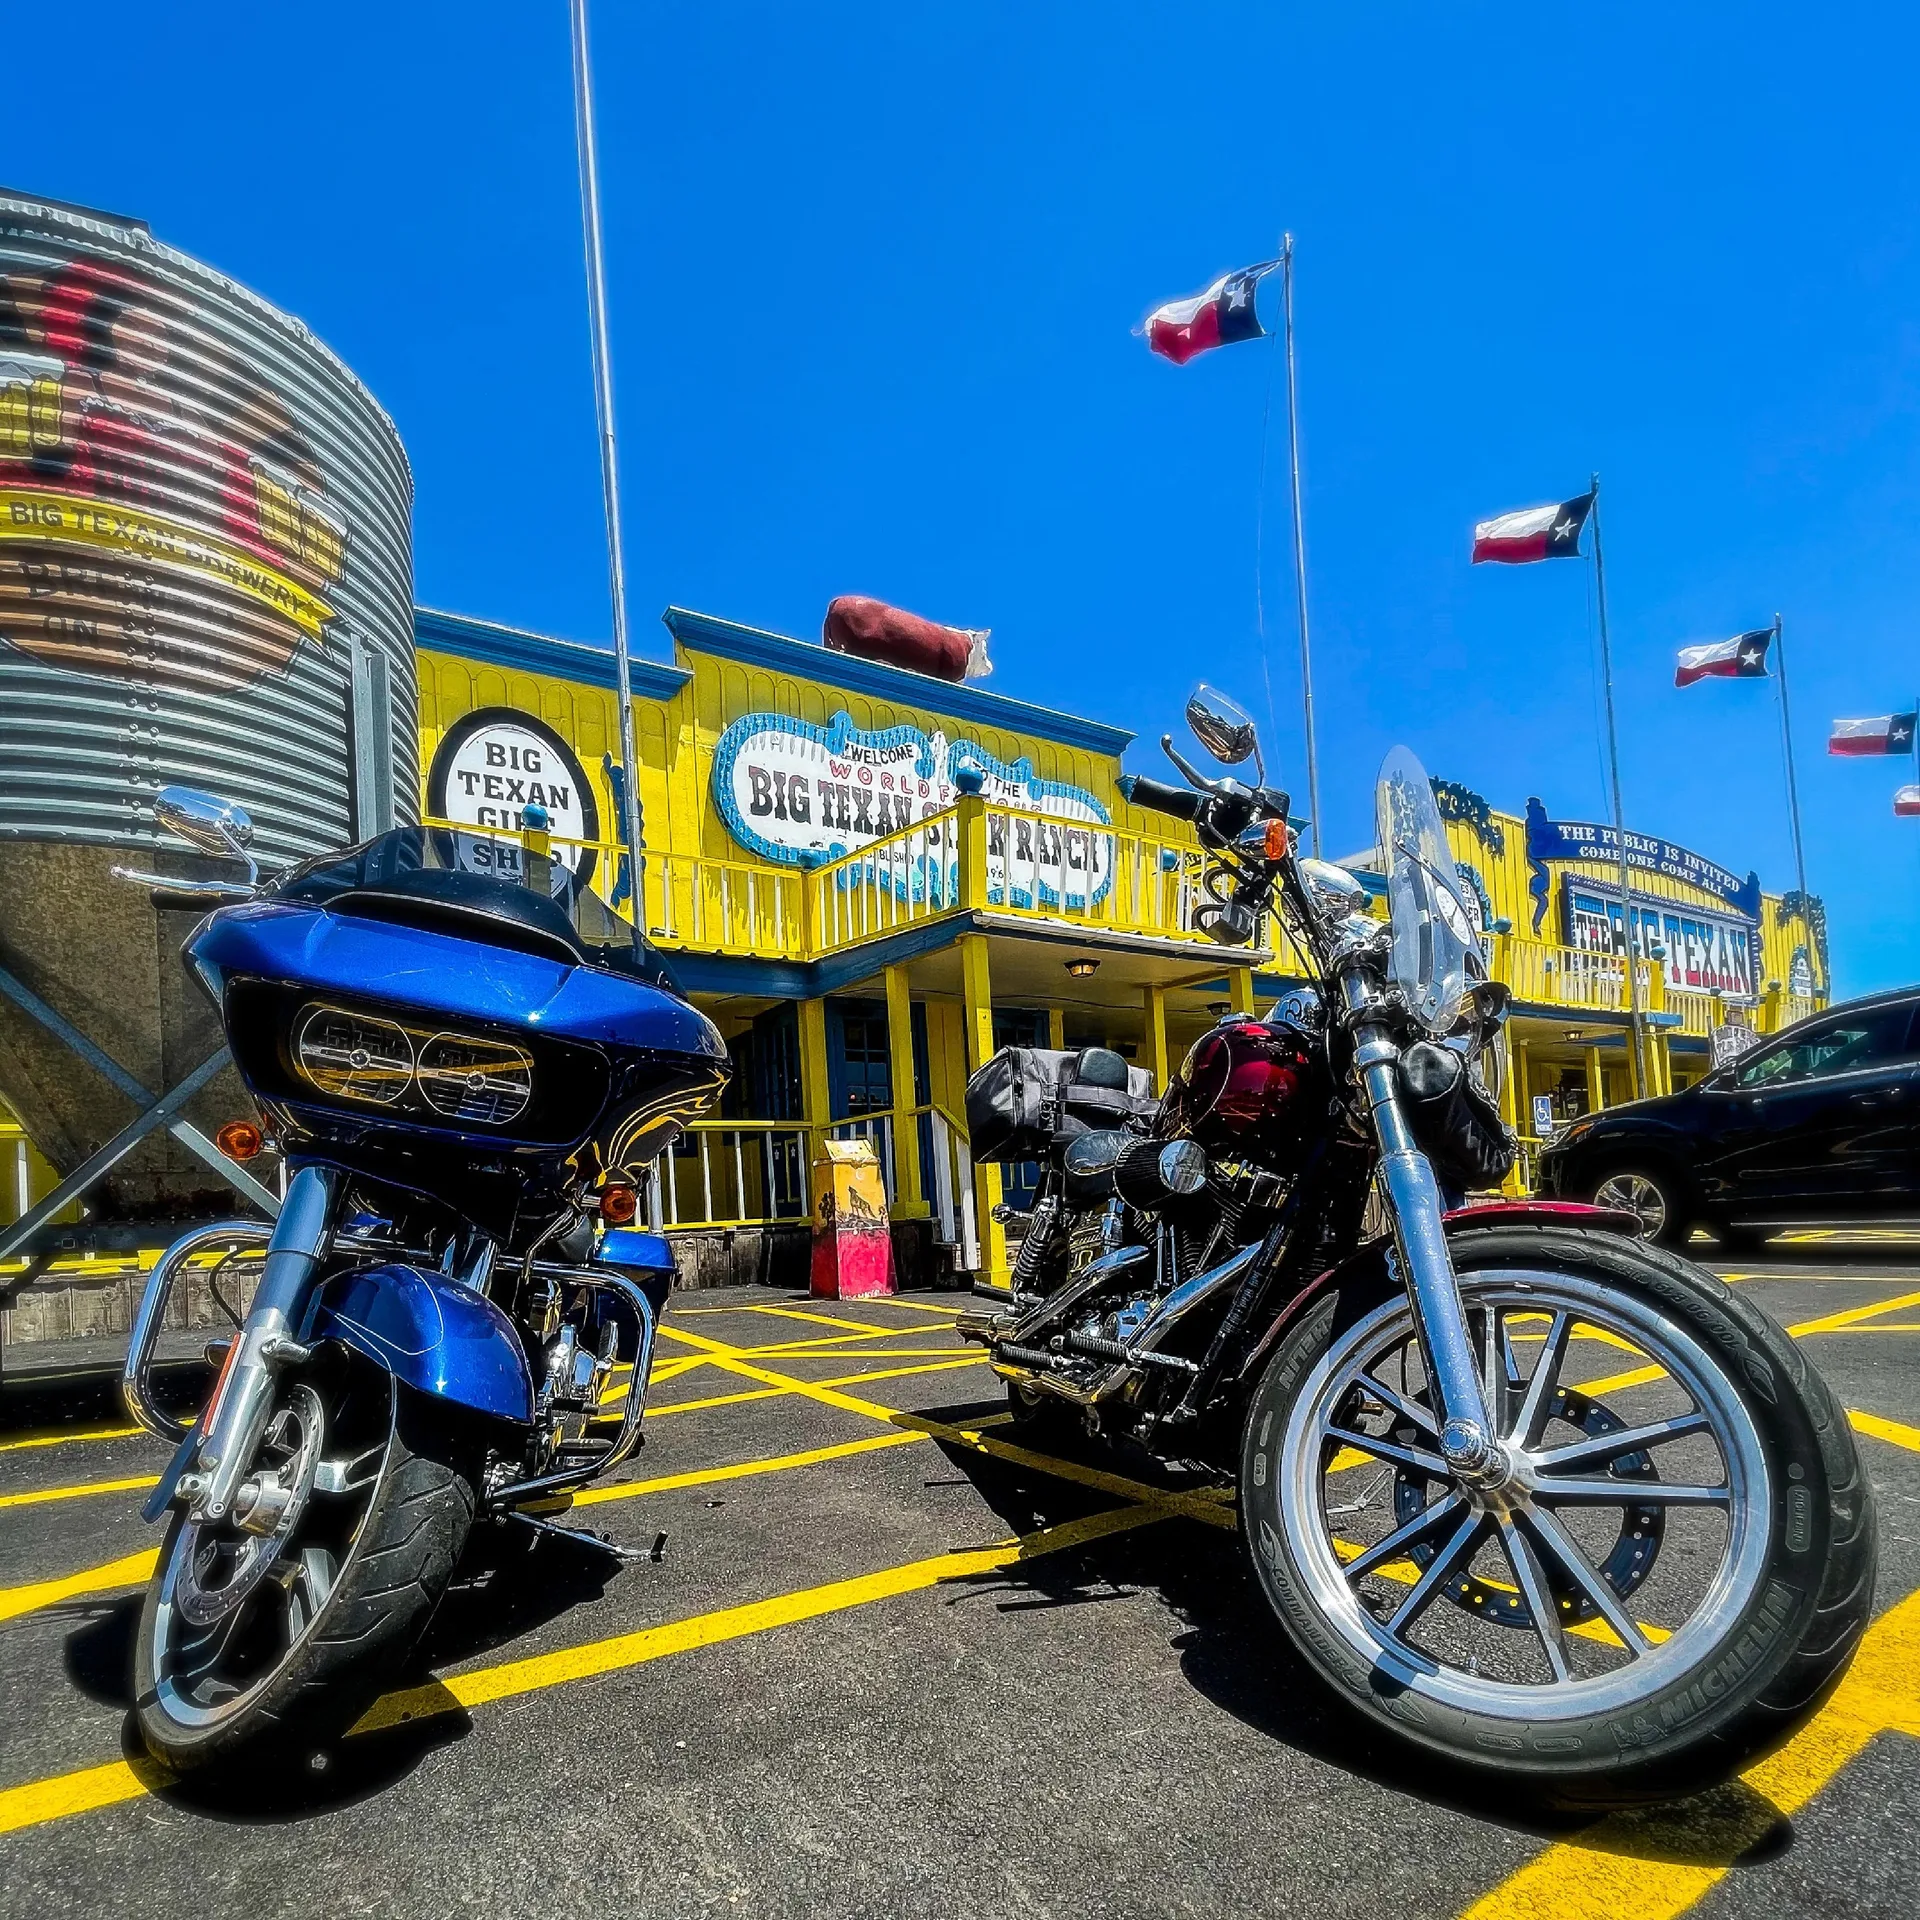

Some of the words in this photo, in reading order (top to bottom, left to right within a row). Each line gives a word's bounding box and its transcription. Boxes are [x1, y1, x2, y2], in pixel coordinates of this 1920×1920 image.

[10, 501, 63, 527] BIG
[70, 507, 178, 553] TEXAN
[484, 741, 542, 773] BIG
[829, 759, 930, 799] WORLD
[851, 744, 914, 765] WELCOME
[457, 770, 569, 810] TEXAN
[748, 765, 811, 825] BIG
[817, 780, 912, 839] TEXAN
[994, 777, 1021, 798] THE
[472, 843, 563, 872] SHP
[1015, 818, 1100, 873] RANCH
[1558, 825, 1596, 842] THE
[1601, 829, 1659, 855] PUBLIC
[1664, 845, 1680, 861] IS
[1684, 853, 1741, 893] INVITED
[1579, 846, 1621, 861] COME
[1627, 852, 1657, 869] ONE
[1660, 861, 1697, 881] COME
[1701, 879, 1725, 897] ALL
[1575, 913, 1611, 969] THE
[1663, 913, 1751, 995] TEXAN
[1278, 1315, 1332, 1390] HELIN
[1273, 1568, 1348, 1670] COMMANDER
[1658, 1582, 1796, 1726] MICHELIN
